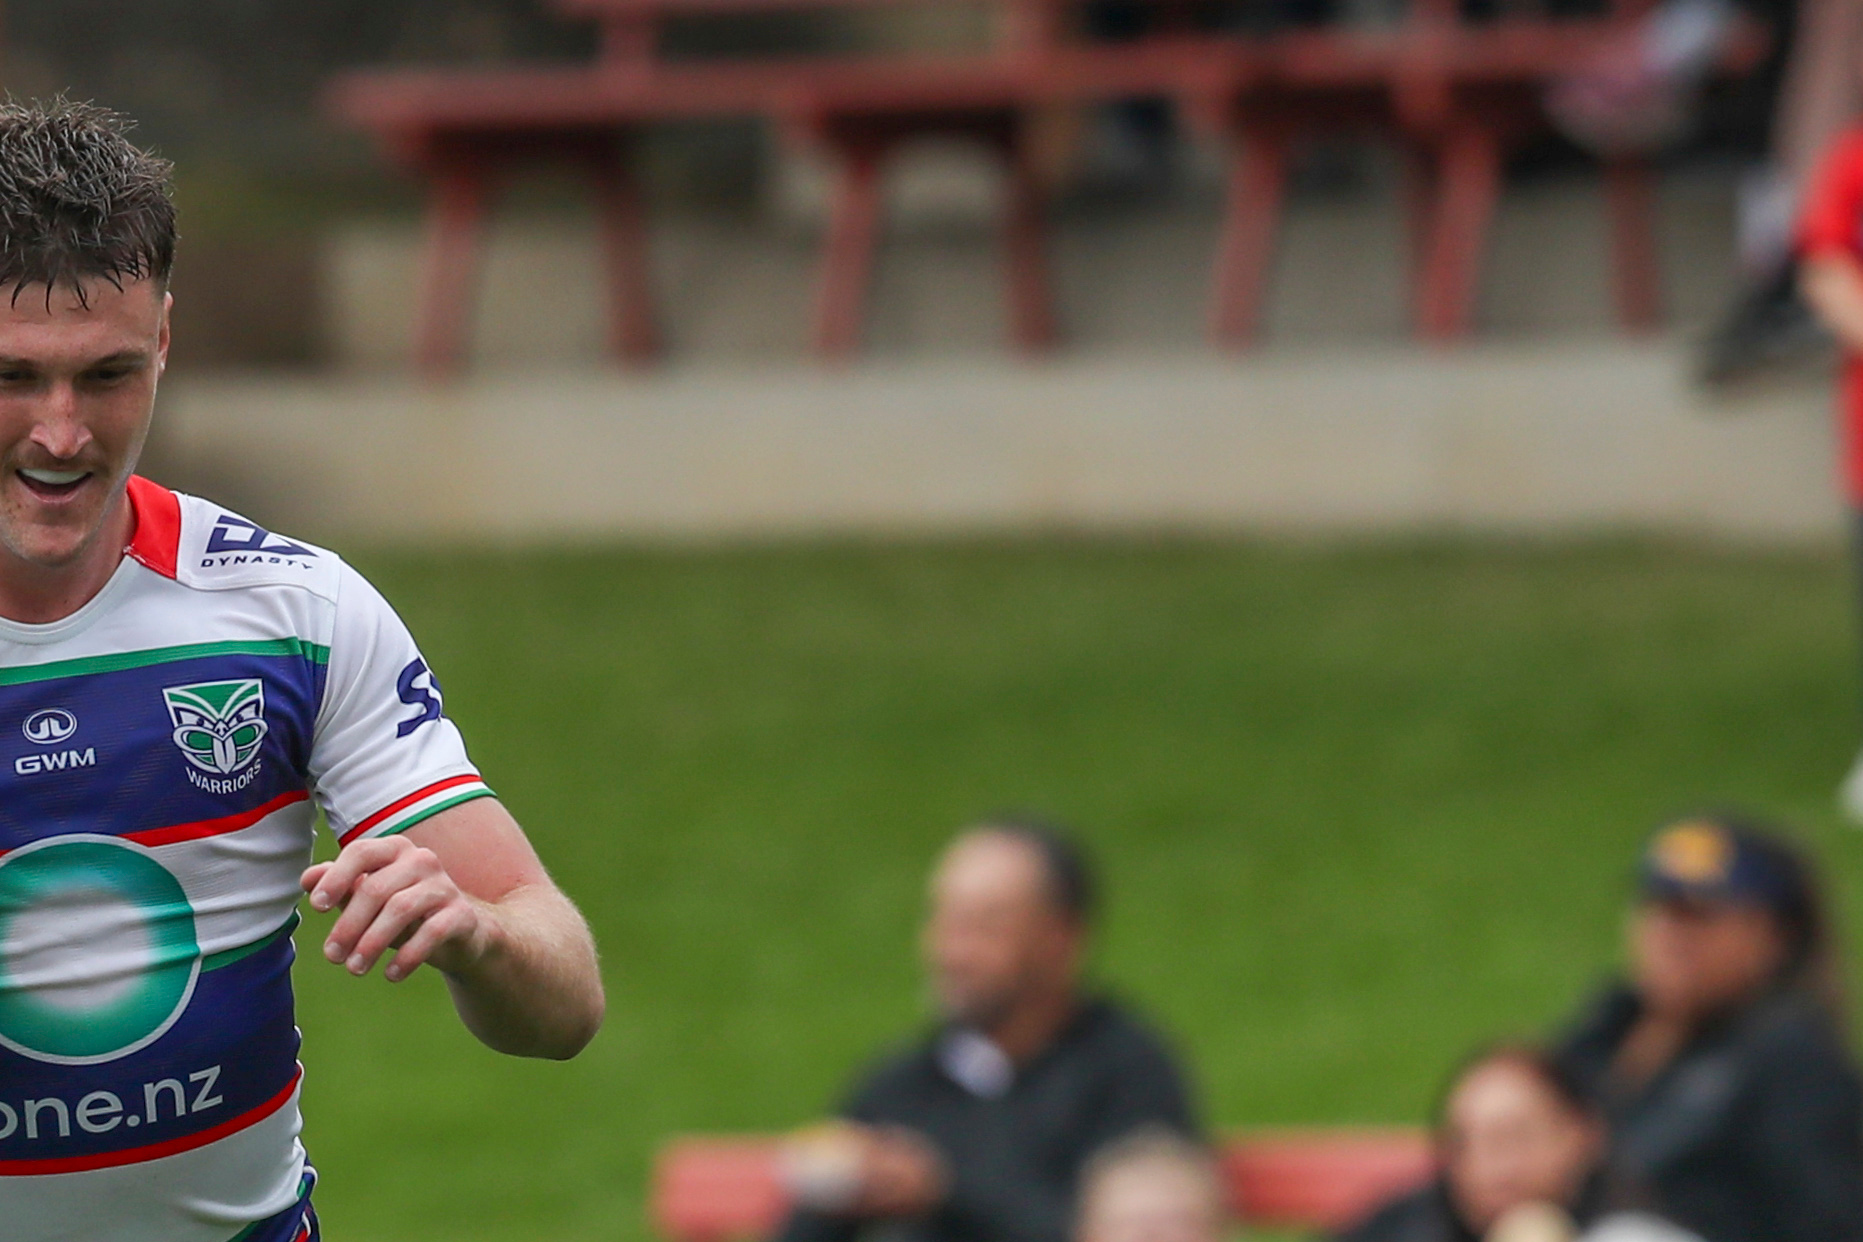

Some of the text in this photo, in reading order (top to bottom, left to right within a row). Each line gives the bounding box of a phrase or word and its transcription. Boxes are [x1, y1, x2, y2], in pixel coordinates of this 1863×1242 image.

[200, 554, 314, 569] DYNASTY
[14, 746, 96, 775] GWM
[184, 757, 263, 795] WARRIORS
